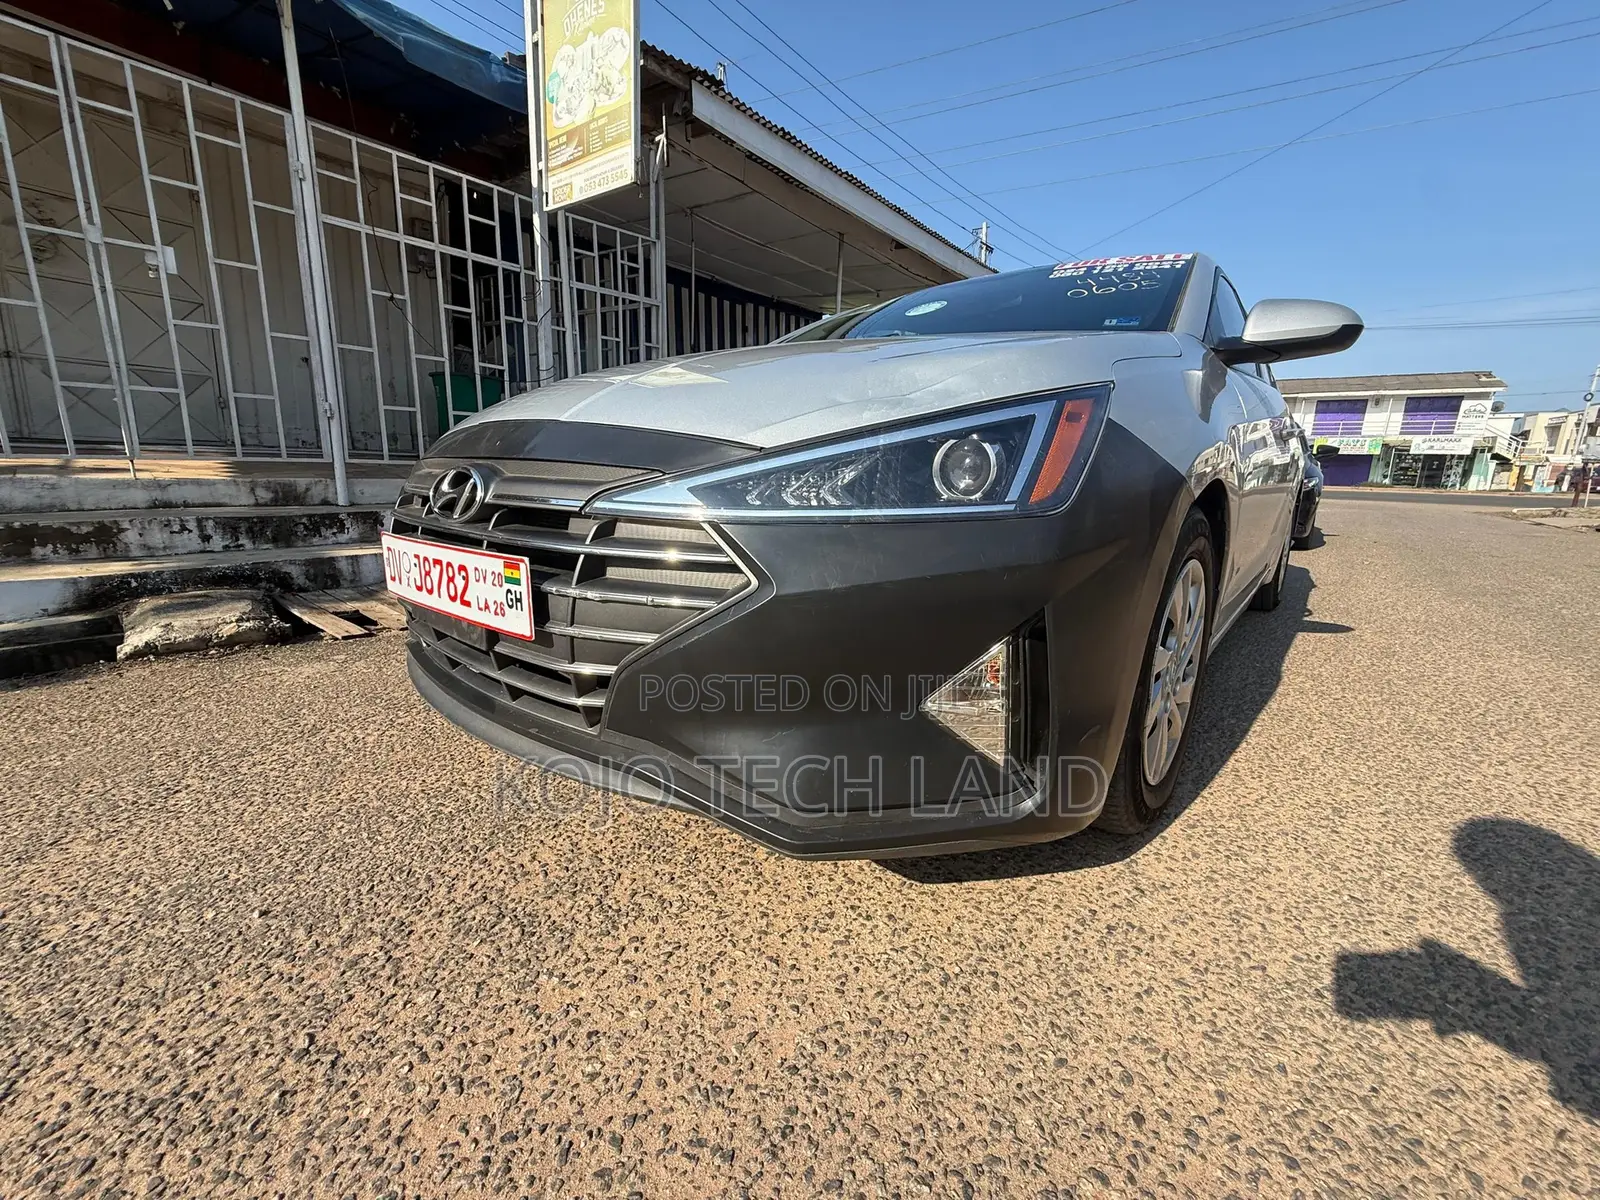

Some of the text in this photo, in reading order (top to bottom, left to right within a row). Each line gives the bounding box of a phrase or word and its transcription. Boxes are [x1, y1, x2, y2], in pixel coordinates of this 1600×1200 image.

[386, 546, 472, 609] DV J8782
[474, 566, 504, 588] DV 20
[476, 595, 506, 618] LA 26
[505, 588, 524, 612] GH
